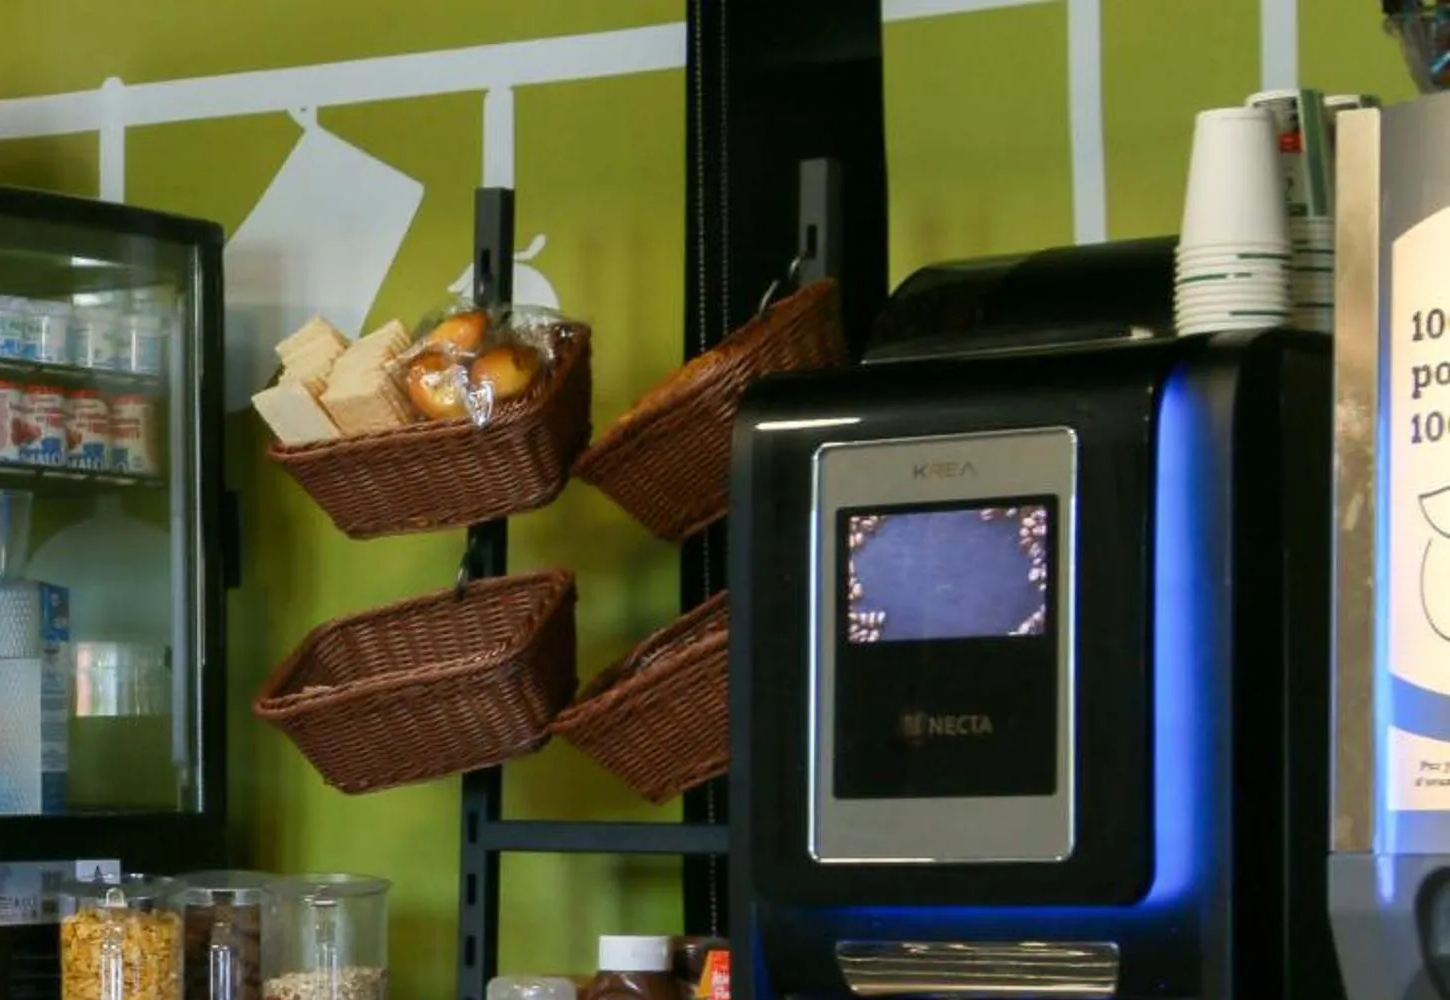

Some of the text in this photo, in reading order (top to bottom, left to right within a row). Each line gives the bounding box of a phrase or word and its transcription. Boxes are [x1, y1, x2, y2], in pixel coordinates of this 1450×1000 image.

[1411, 308, 1450, 342] 10
[1411, 411, 1450, 443] 10
[929, 715, 994, 736] NECTA
